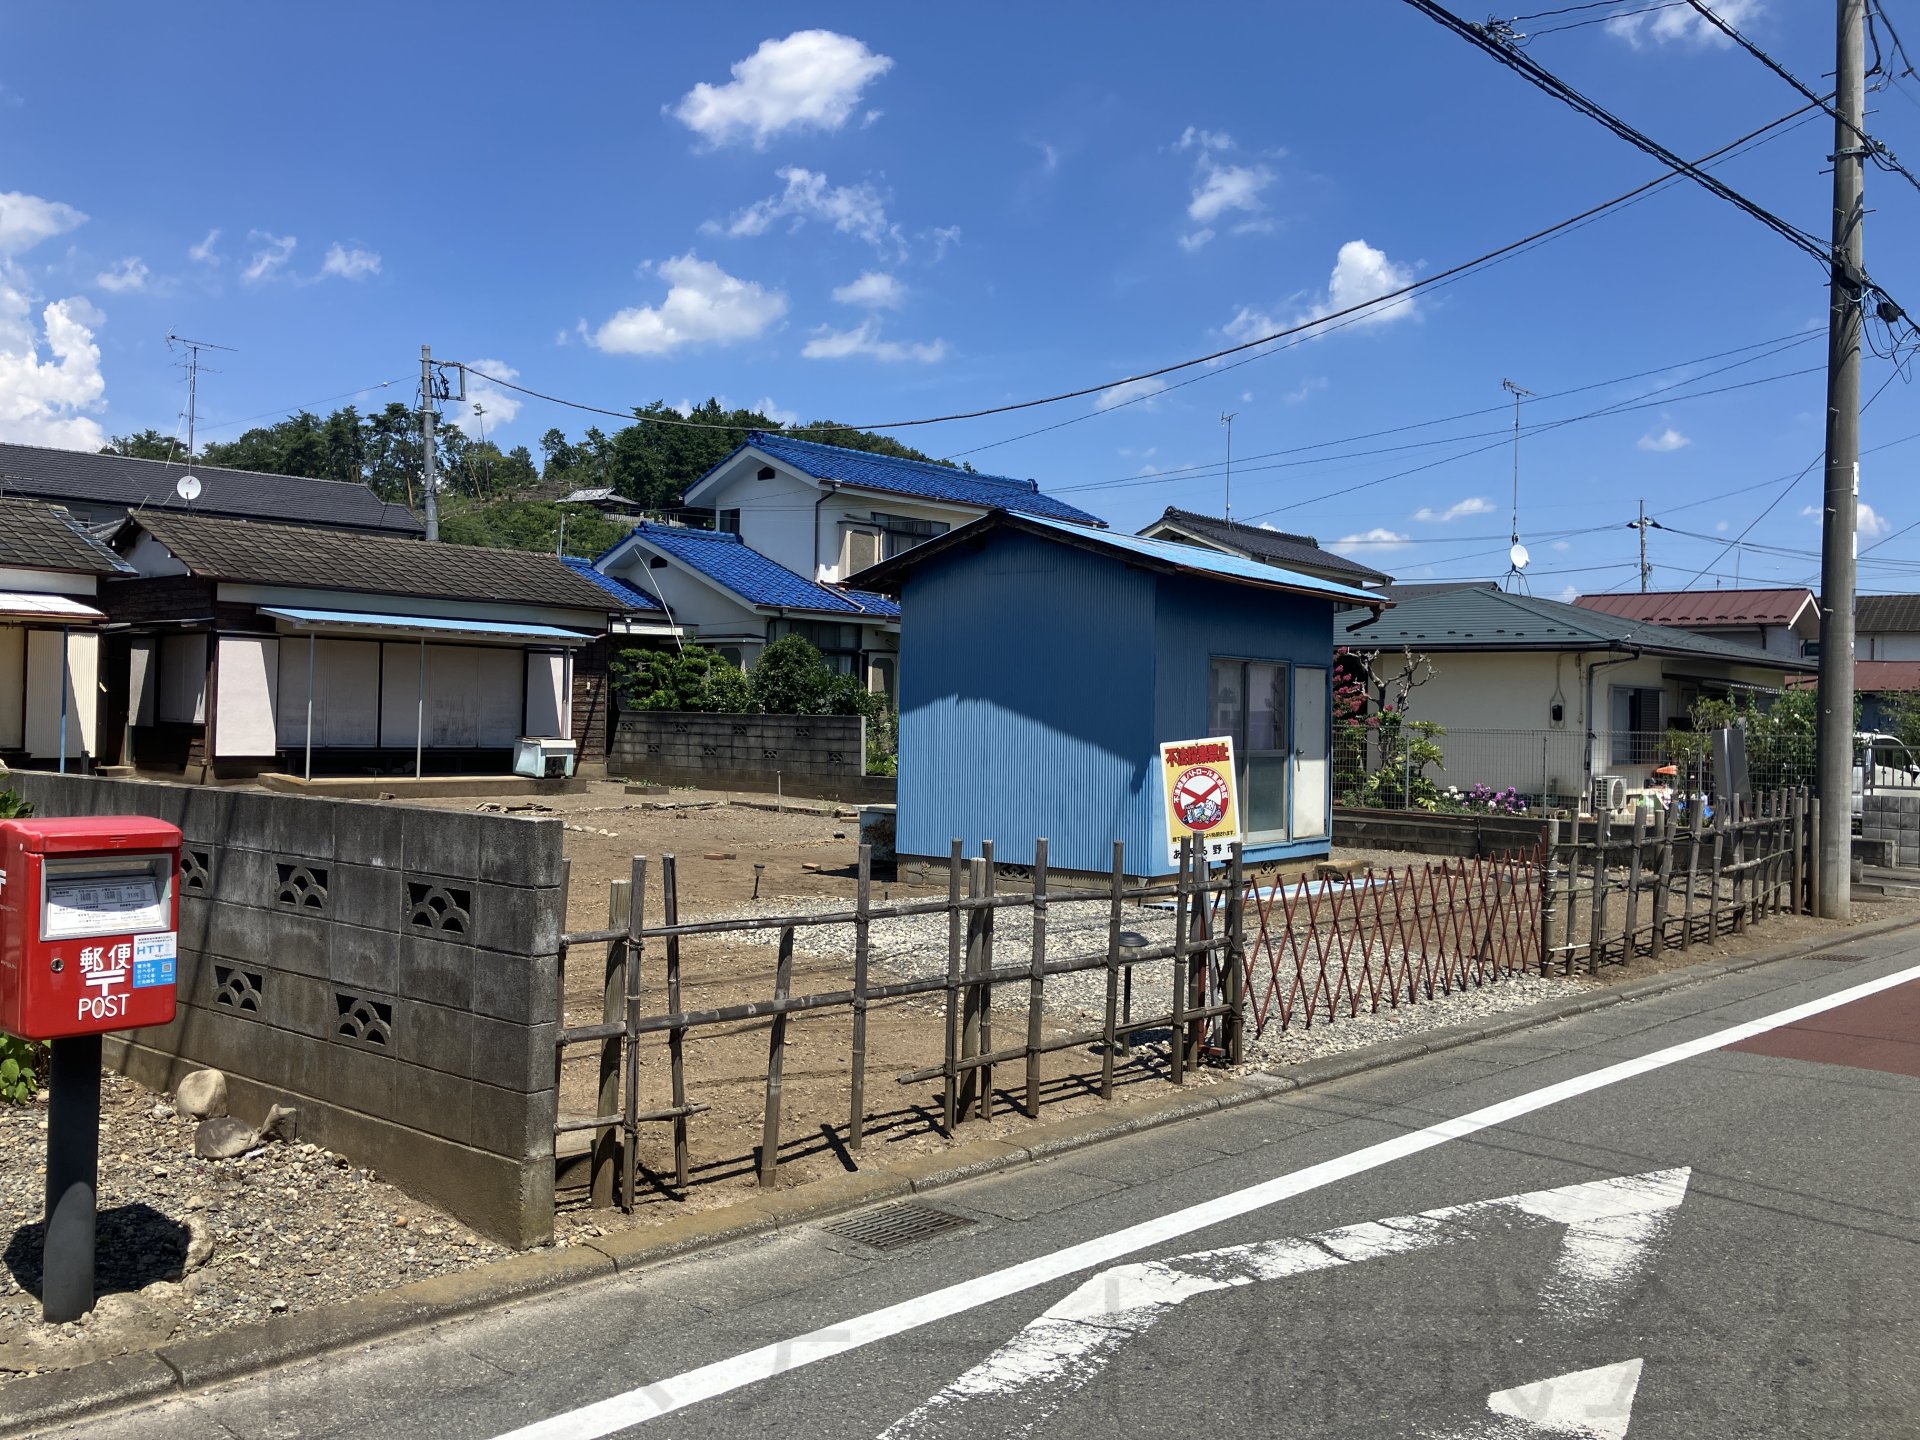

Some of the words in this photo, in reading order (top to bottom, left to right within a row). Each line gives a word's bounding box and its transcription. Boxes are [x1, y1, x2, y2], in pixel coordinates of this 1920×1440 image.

[1165, 742, 1230, 767] 不法投棄禁止
[79, 943, 131, 974] 郵便
[78, 993, 130, 1020] POST
